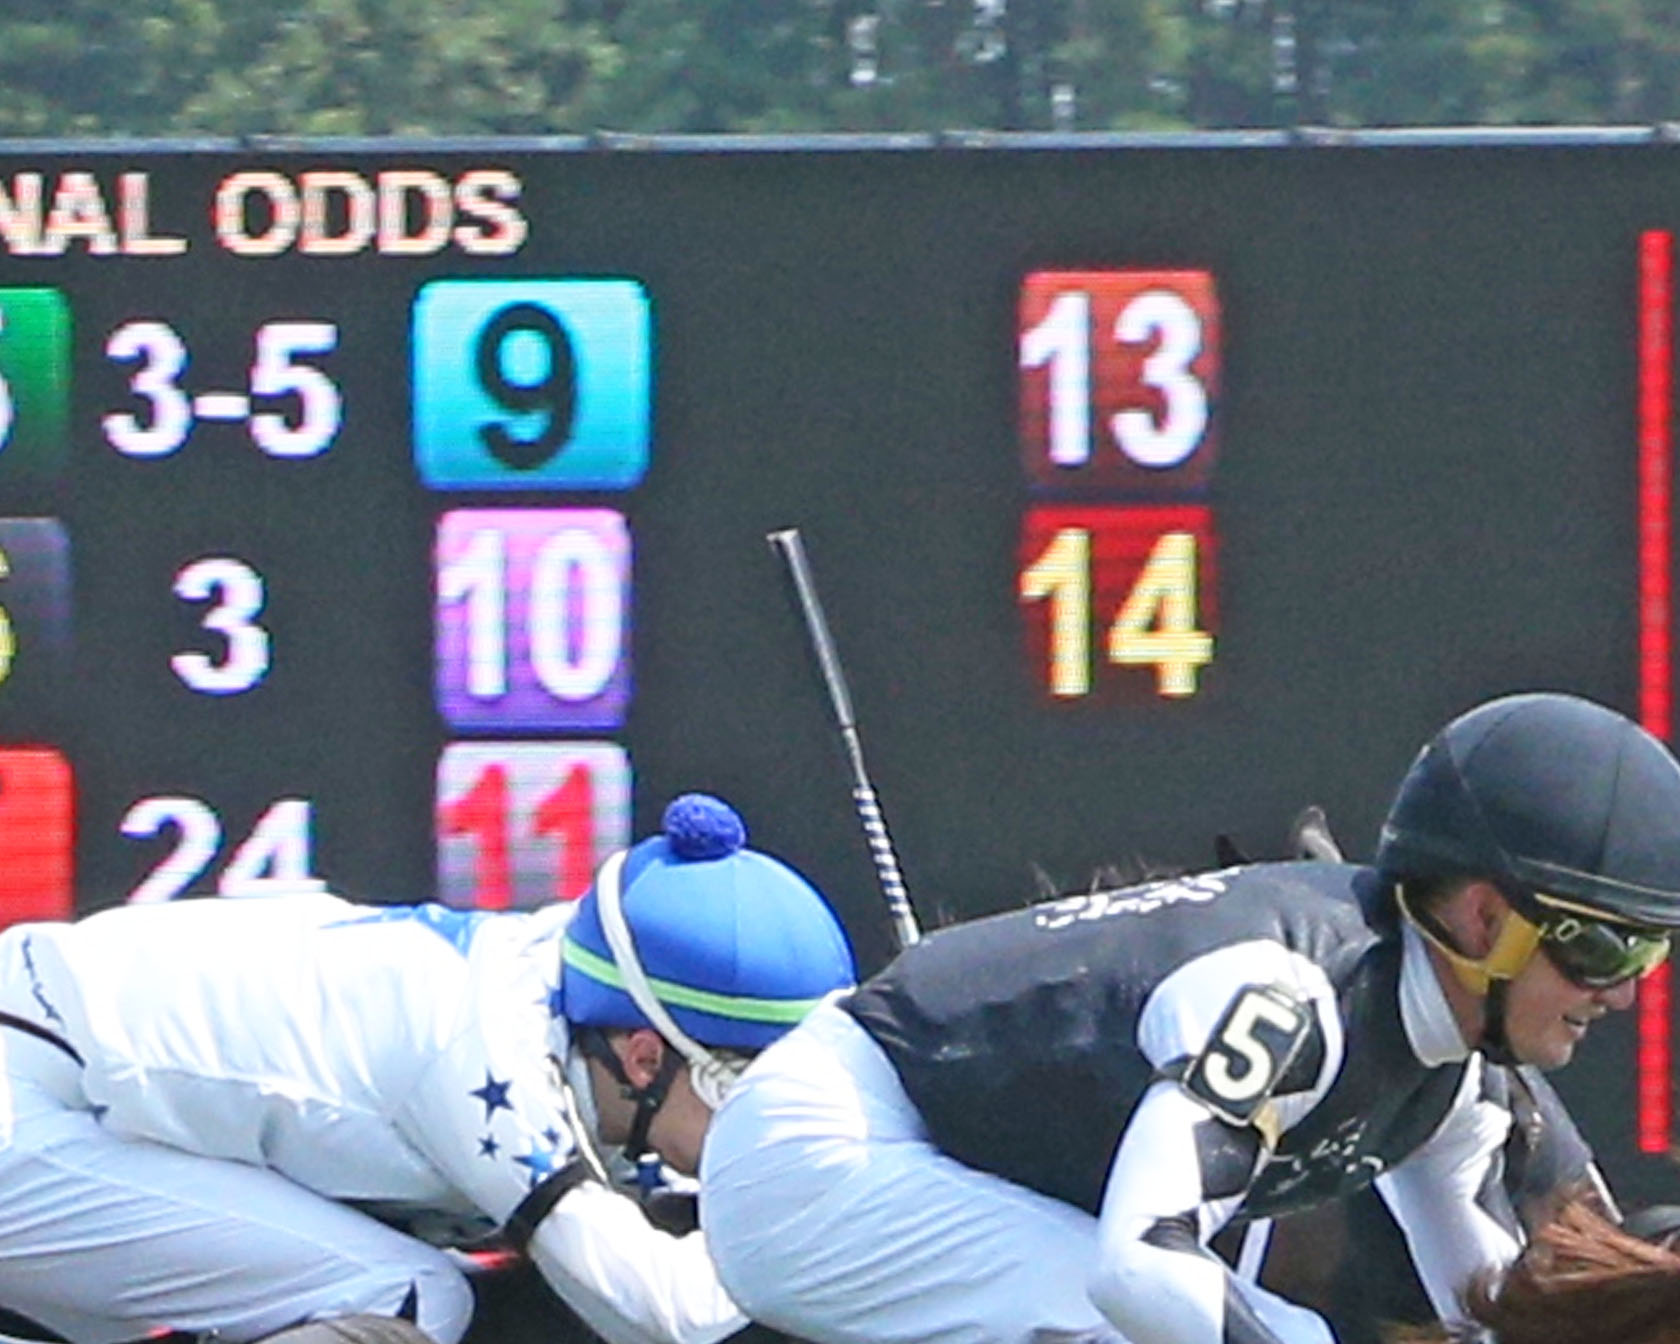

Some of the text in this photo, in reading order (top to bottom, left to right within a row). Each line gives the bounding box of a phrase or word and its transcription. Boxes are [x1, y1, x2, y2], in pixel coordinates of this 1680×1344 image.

[212, 170, 527, 255] ODDS
[102, 322, 343, 458] 3-5
[474, 302, 578, 470] 9
[1020, 290, 1208, 467] 13
[170, 558, 270, 695] 3
[438, 530, 624, 700] 10
[1020, 528, 1213, 696] 14
[122, 797, 327, 905] 24
[442, 763, 596, 906] 11
[1203, 1000, 1298, 1100] 5
